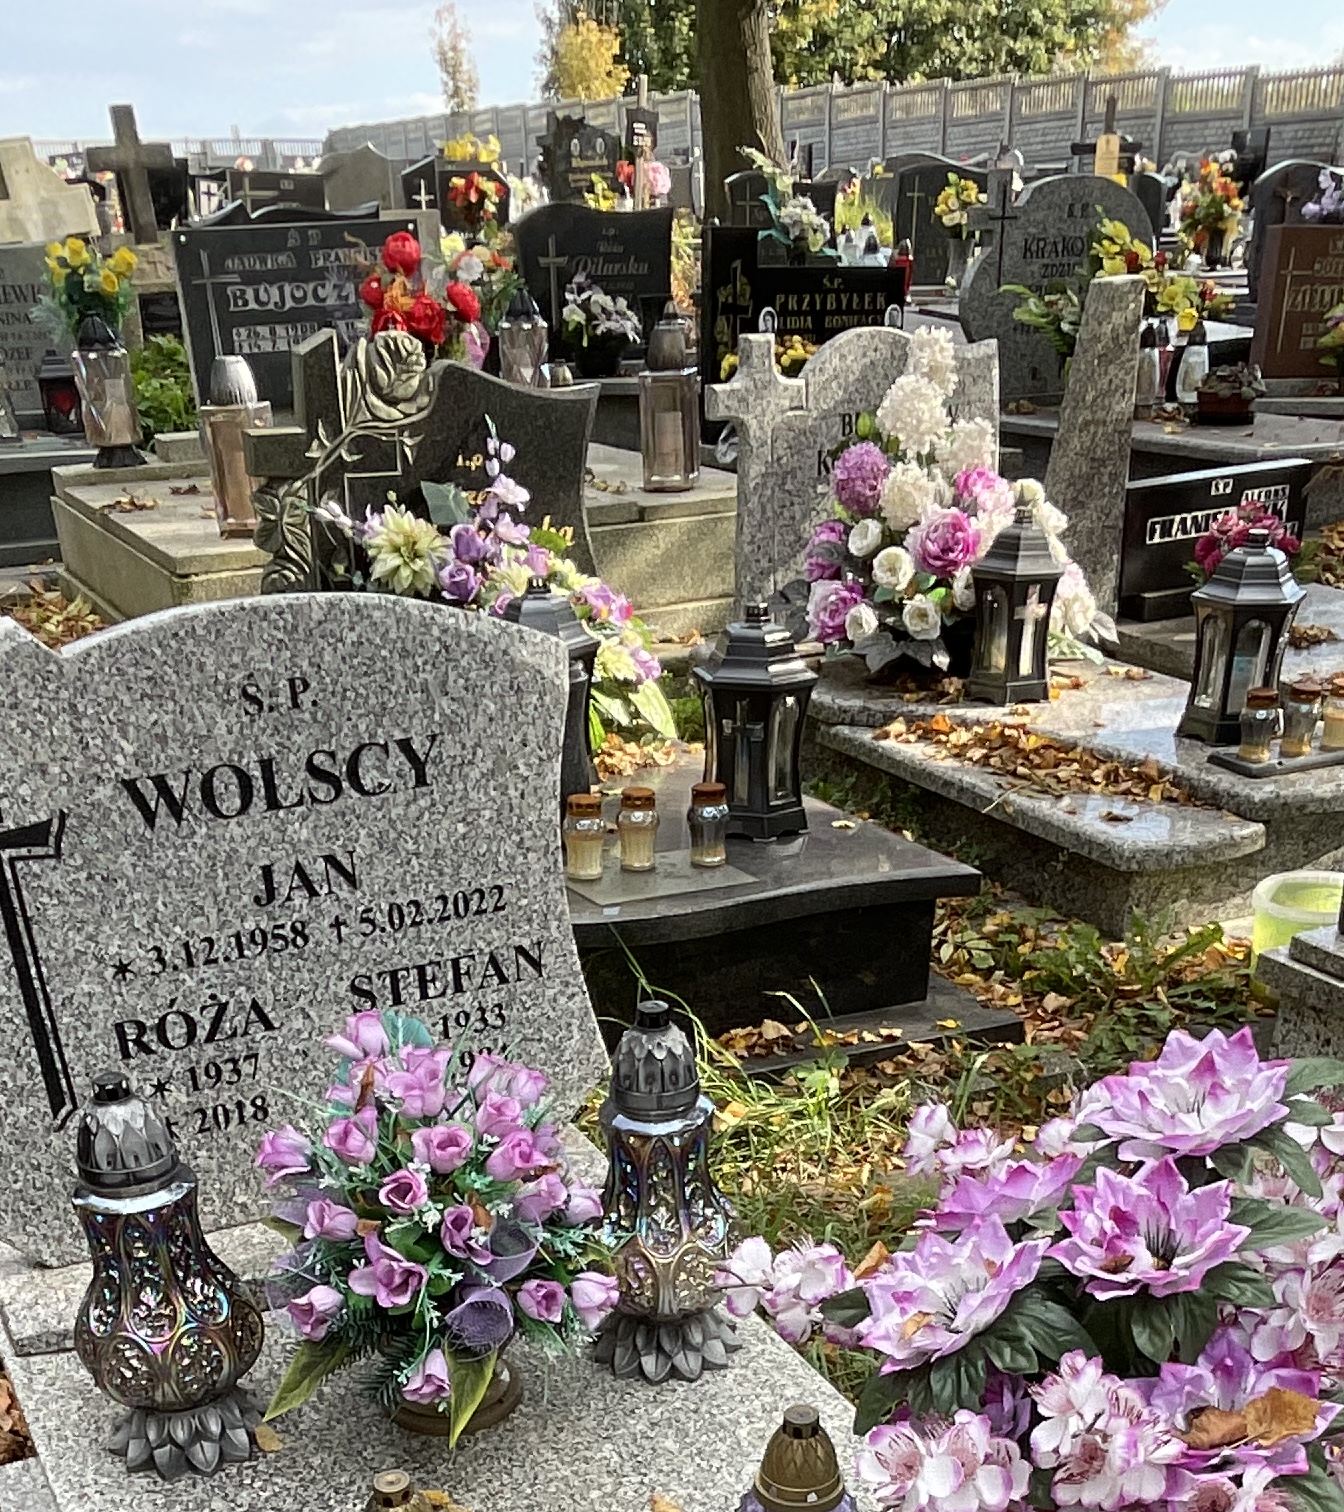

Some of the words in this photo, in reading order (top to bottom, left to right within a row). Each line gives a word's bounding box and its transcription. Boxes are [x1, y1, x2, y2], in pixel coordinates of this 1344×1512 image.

[775, 292, 888, 311] PRZYBYŁEK
[121, 732, 441, 832] WOLSCY
[254, 850, 359, 908] JAN
[114, 990, 280, 1060] RÓŻA
[350, 940, 544, 1013] STEFAN
[185, 1053, 259, 1092] 1937
[432, 1002, 506, 1039] 1933
[194, 1095, 269, 1134] 2018
